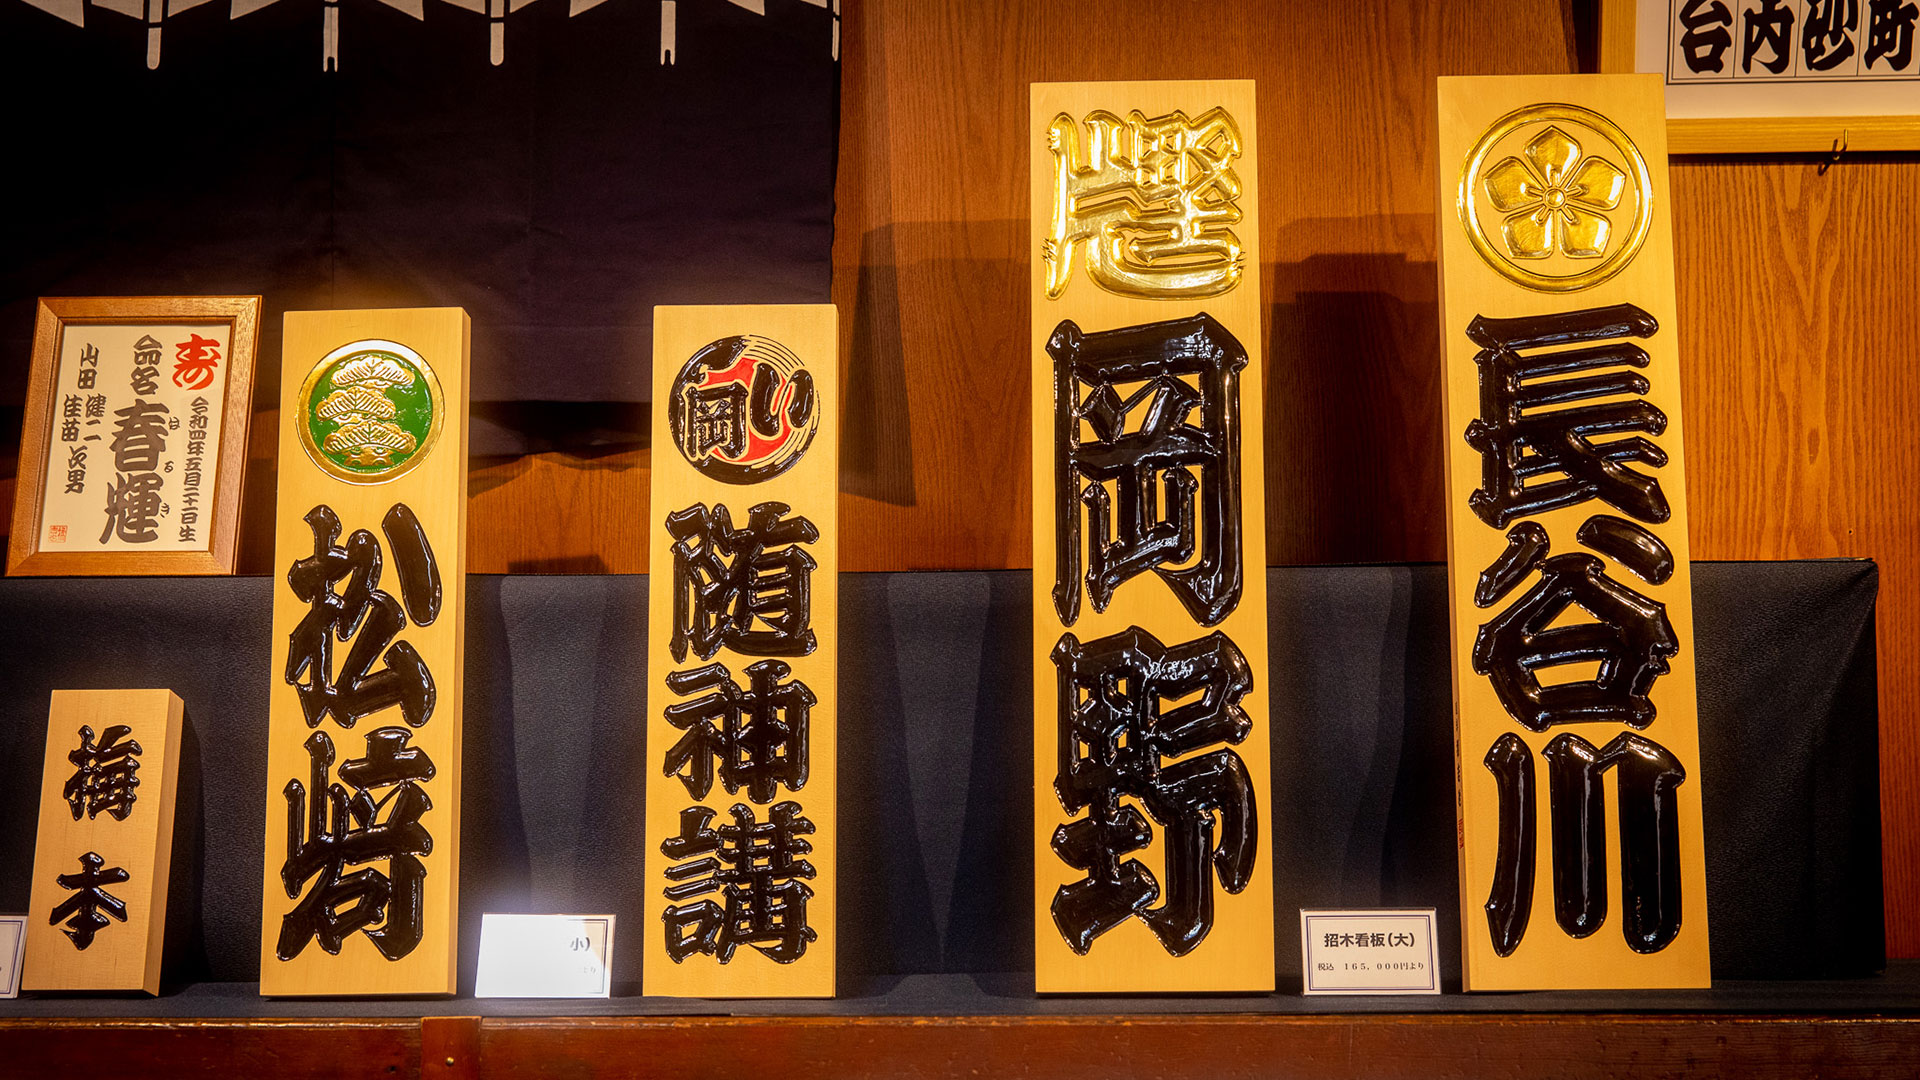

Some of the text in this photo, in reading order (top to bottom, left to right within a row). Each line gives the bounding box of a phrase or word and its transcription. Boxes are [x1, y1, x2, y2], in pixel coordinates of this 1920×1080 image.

[77, 343, 99, 390] 山田
[1465, 302, 1687, 958] 長谷川
[1324, 932, 1415, 947] 招木看板(大)
